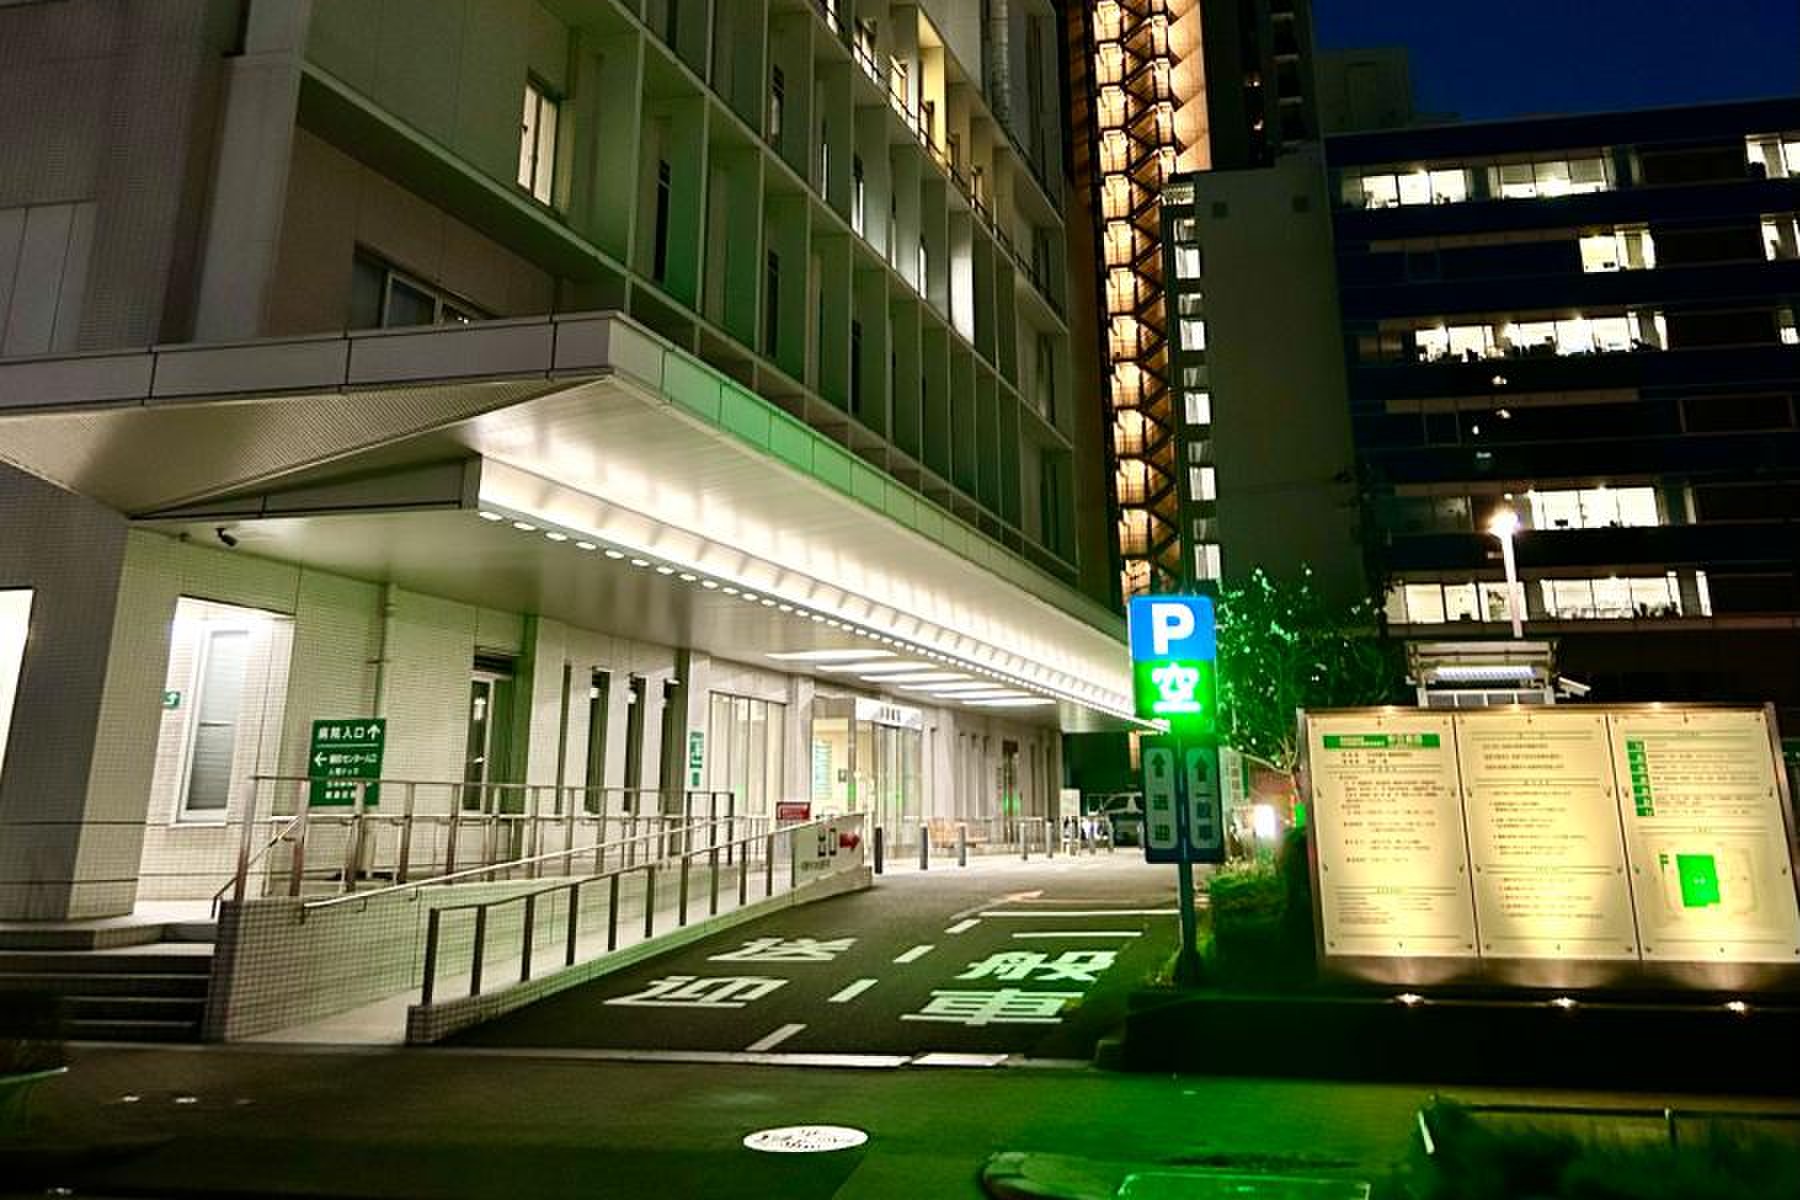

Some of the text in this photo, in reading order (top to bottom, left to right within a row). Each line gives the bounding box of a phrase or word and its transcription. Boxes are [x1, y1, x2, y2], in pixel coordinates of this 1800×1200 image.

[1151, 603, 1195, 655] P
[900, 932, 1144, 1025] 一般車
